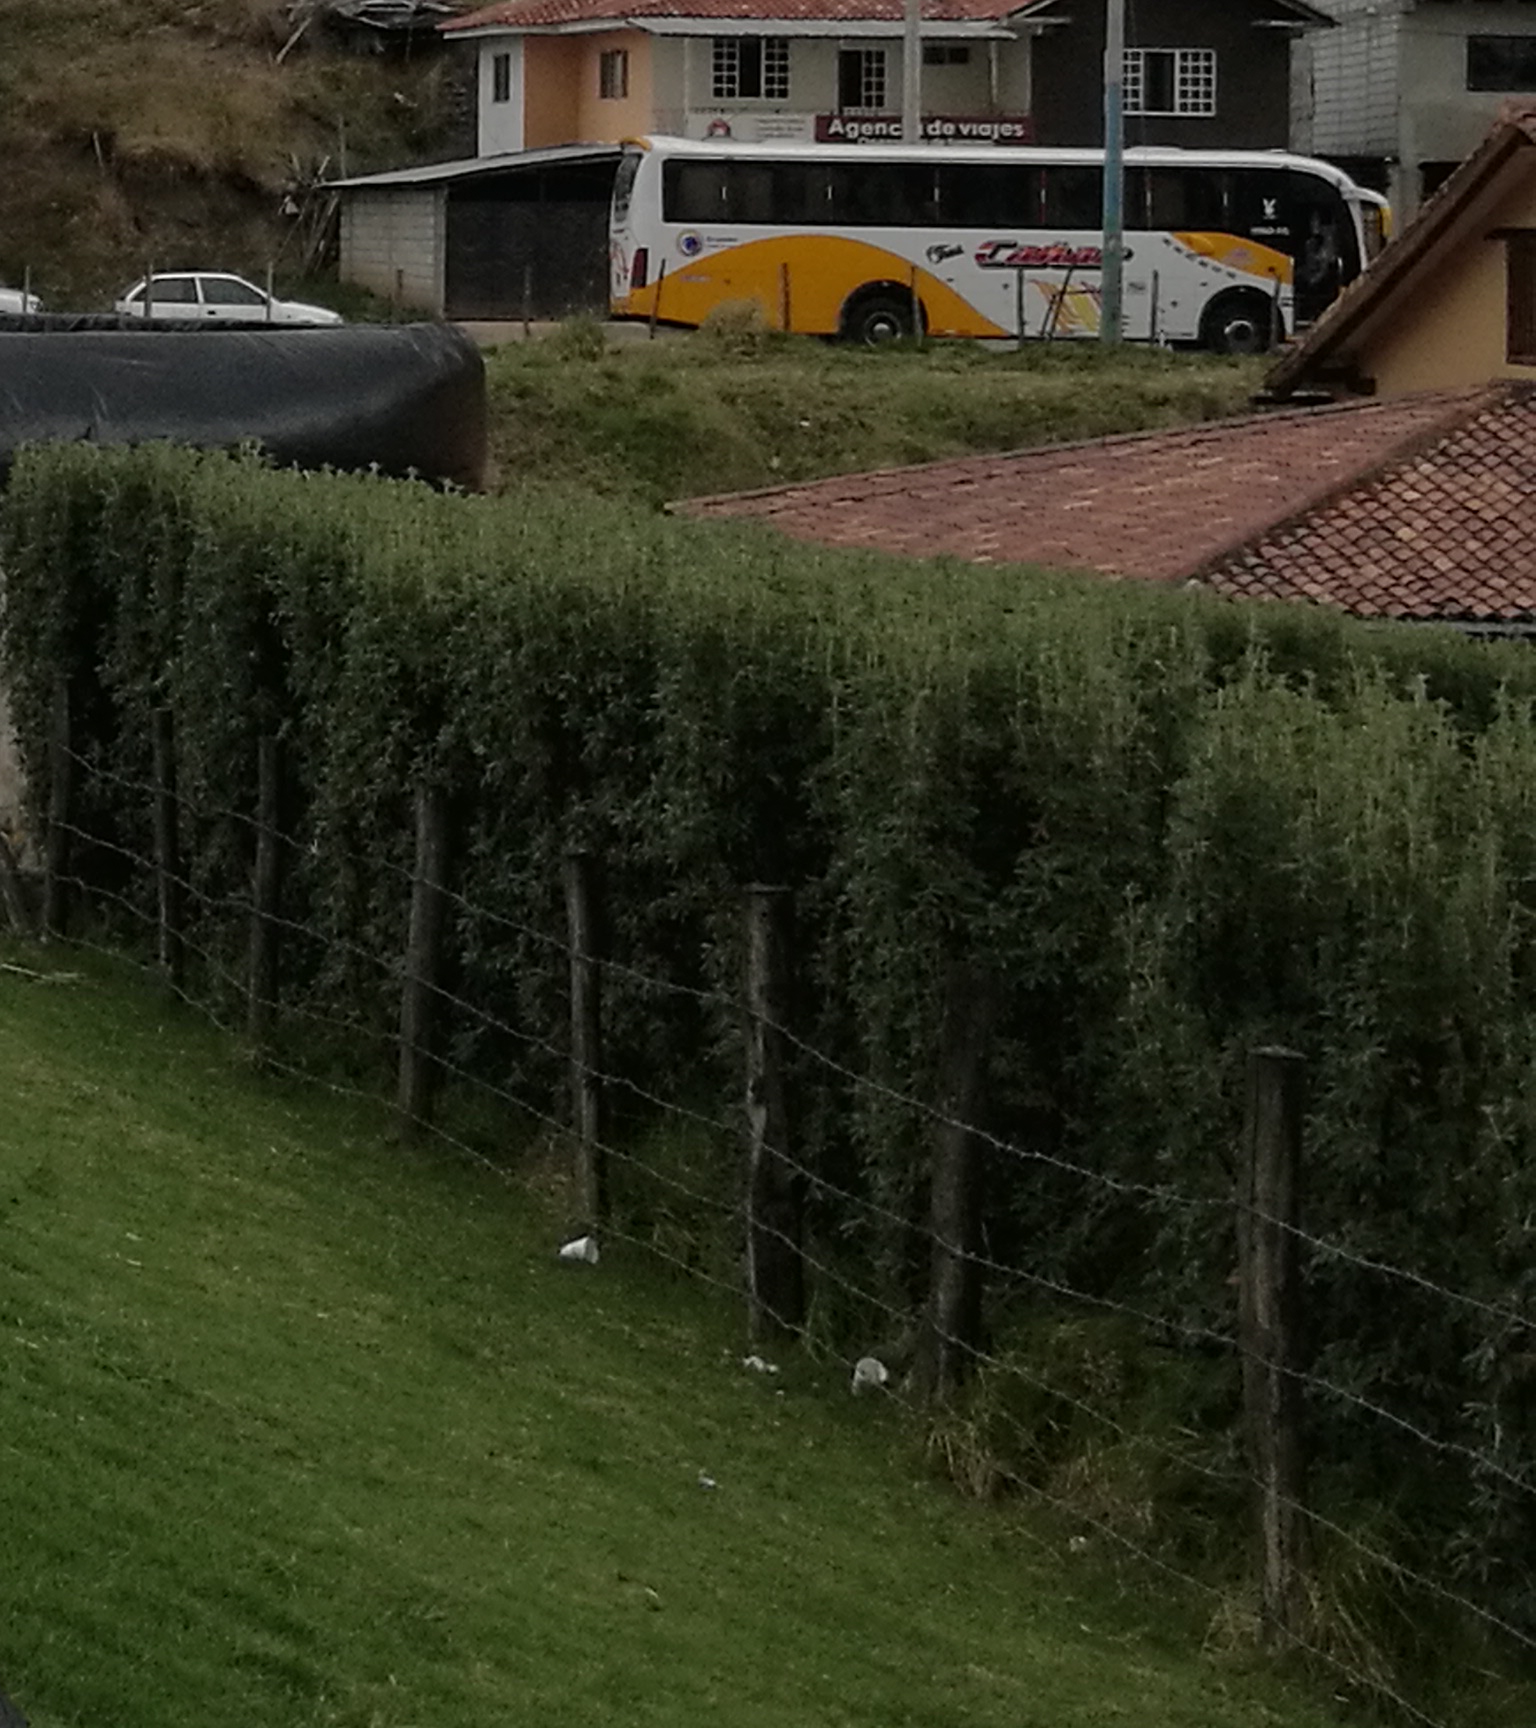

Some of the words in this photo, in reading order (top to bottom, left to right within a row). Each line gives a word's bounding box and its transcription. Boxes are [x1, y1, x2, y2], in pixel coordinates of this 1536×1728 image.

[828, 119, 925, 137] Agenc
[927, 119, 954, 134] de
[958, 121, 1025, 138] viajes
